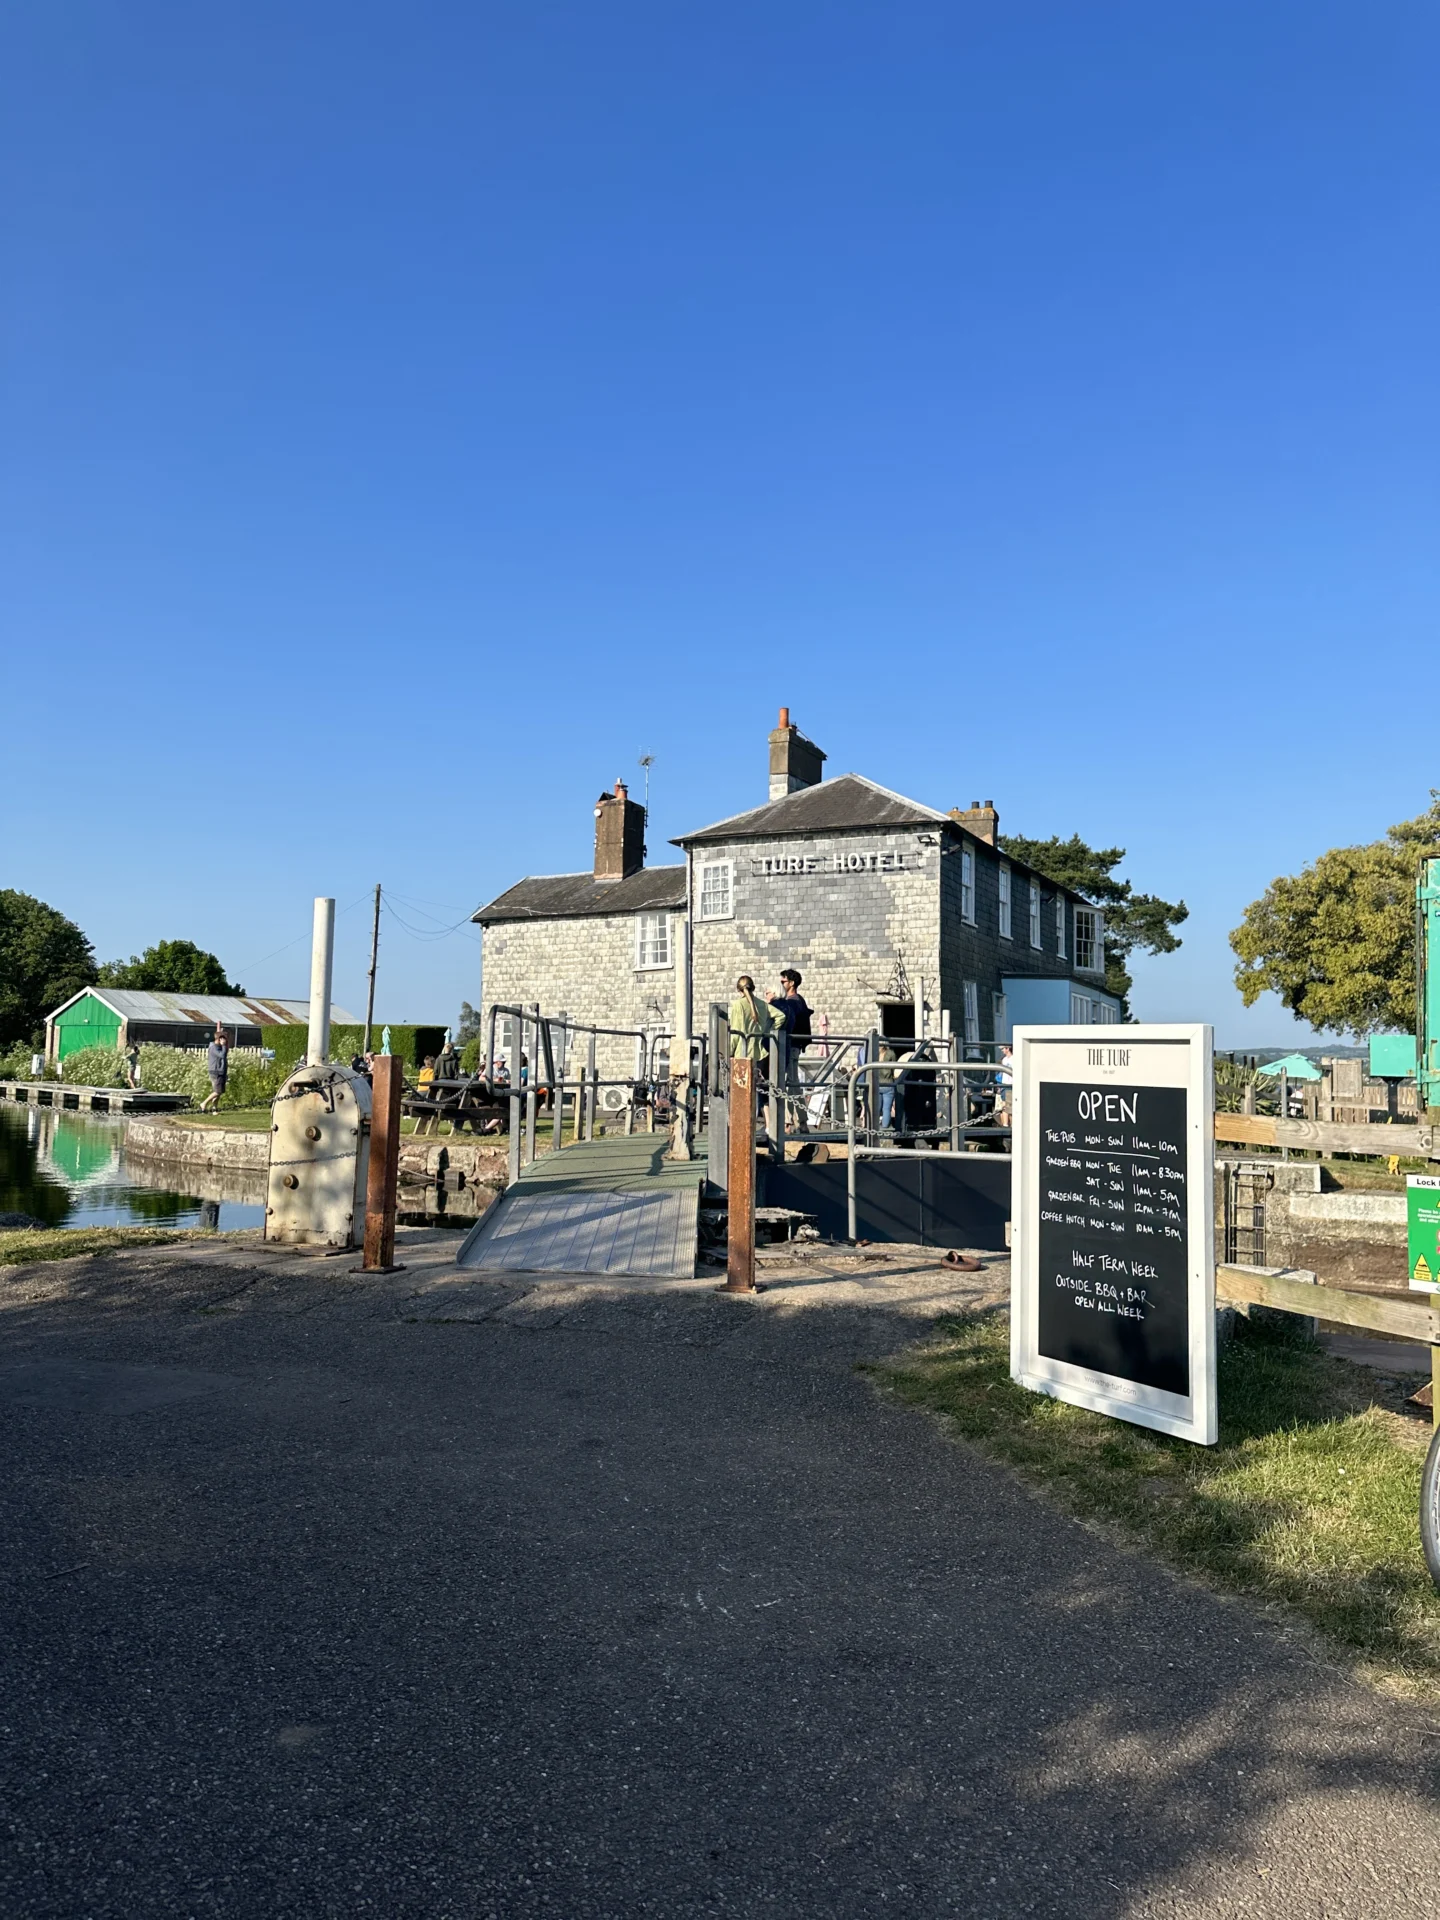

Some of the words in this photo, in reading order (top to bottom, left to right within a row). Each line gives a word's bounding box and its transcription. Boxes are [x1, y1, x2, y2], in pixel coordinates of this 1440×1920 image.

[758, 854, 814, 873] TURF
[832, 850, 905, 870] HOTEL
[1087, 1048, 1104, 1066] THE
[1107, 1049, 1132, 1066] TURF
[1078, 1091, 1138, 1124] OPEN
[1045, 1129, 1060, 1143] THE
[1060, 1131, 1076, 1144] PUB
[1108, 1135, 1124, 1146] SUN
[1046, 1156, 1069, 1167] GARDEN
[1107, 1162, 1122, 1174] TUE
[1086, 1176, 1100, 1188] SAT
[1110, 1180, 1124, 1192] SUN
[1416, 1178, 1436, 1186] Lock
[1089, 1195, 1100, 1208] FRI
[1108, 1200, 1124, 1211] SUN
[1041, 1210, 1062, 1222] COFFEE
[1066, 1214, 1086, 1228] HUTCH
[1110, 1222, 1124, 1232] SUN
[1072, 1250, 1094, 1268] HALF
[1098, 1254, 1128, 1274] TERM
[1132, 1261, 1158, 1278] WEEK
[1056, 1274, 1092, 1292] OUTSIDE
[1095, 1282, 1118, 1300] BBQ
[1127, 1288, 1156, 1308] BAR
[1074, 1296, 1095, 1308] OPEN
[1098, 1300, 1116, 1312] ALL
[1117, 1304, 1144, 1320] WEEK
[1084, 1376, 1136, 1396] www.the-turf.com
